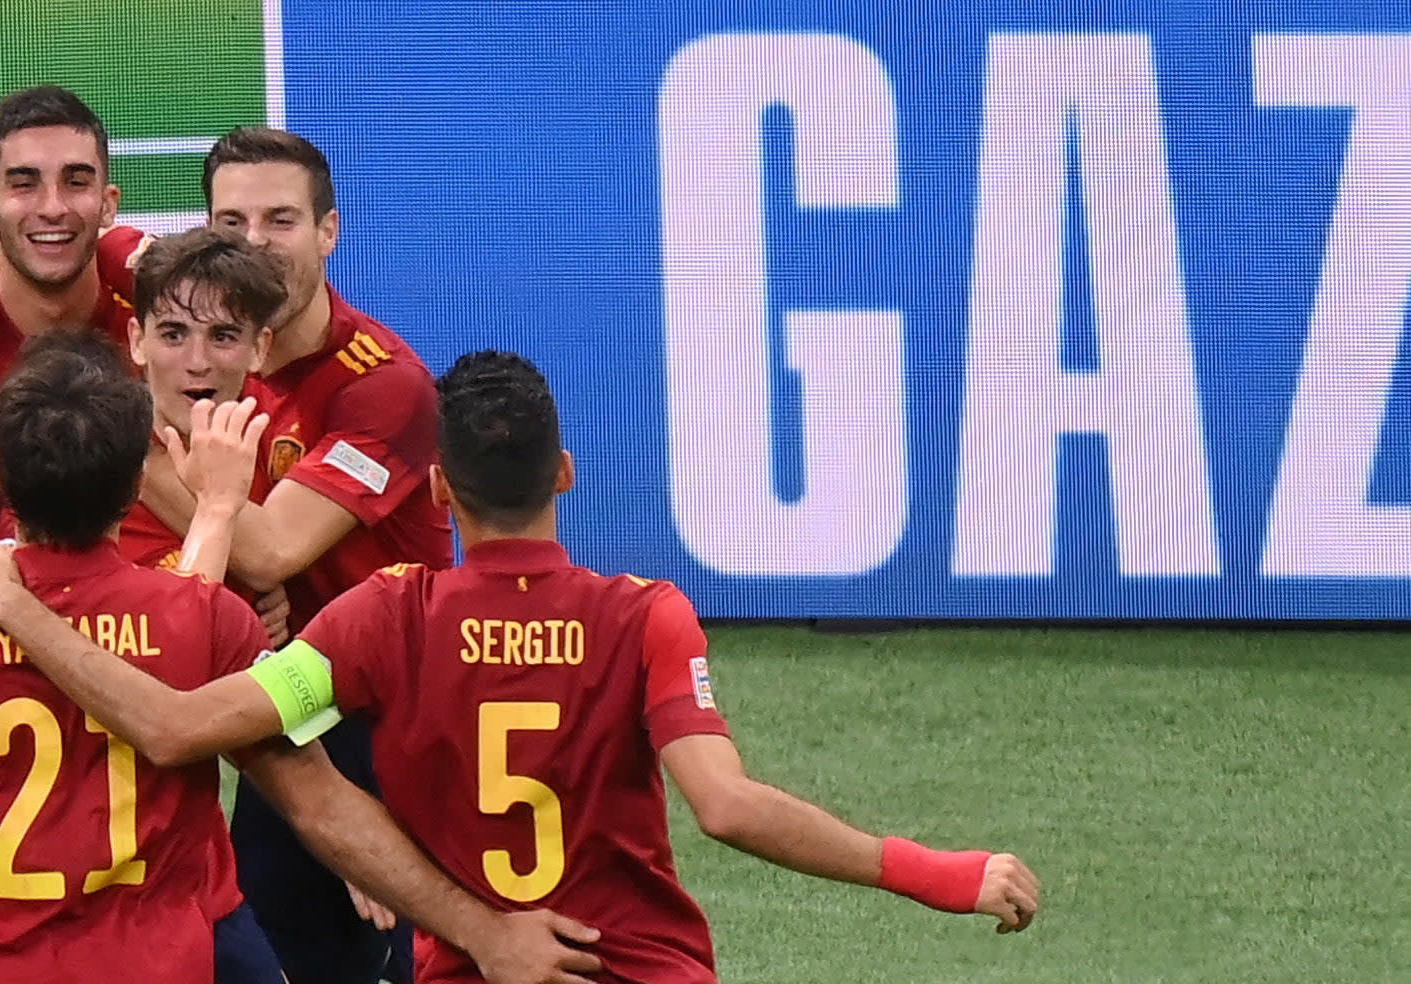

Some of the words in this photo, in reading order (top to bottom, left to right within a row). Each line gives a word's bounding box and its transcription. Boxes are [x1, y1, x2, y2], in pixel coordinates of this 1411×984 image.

[657, 30, 1411, 578] GAZ
[460, 618, 584, 666] SERGIO
[477, 702, 565, 902] 5
